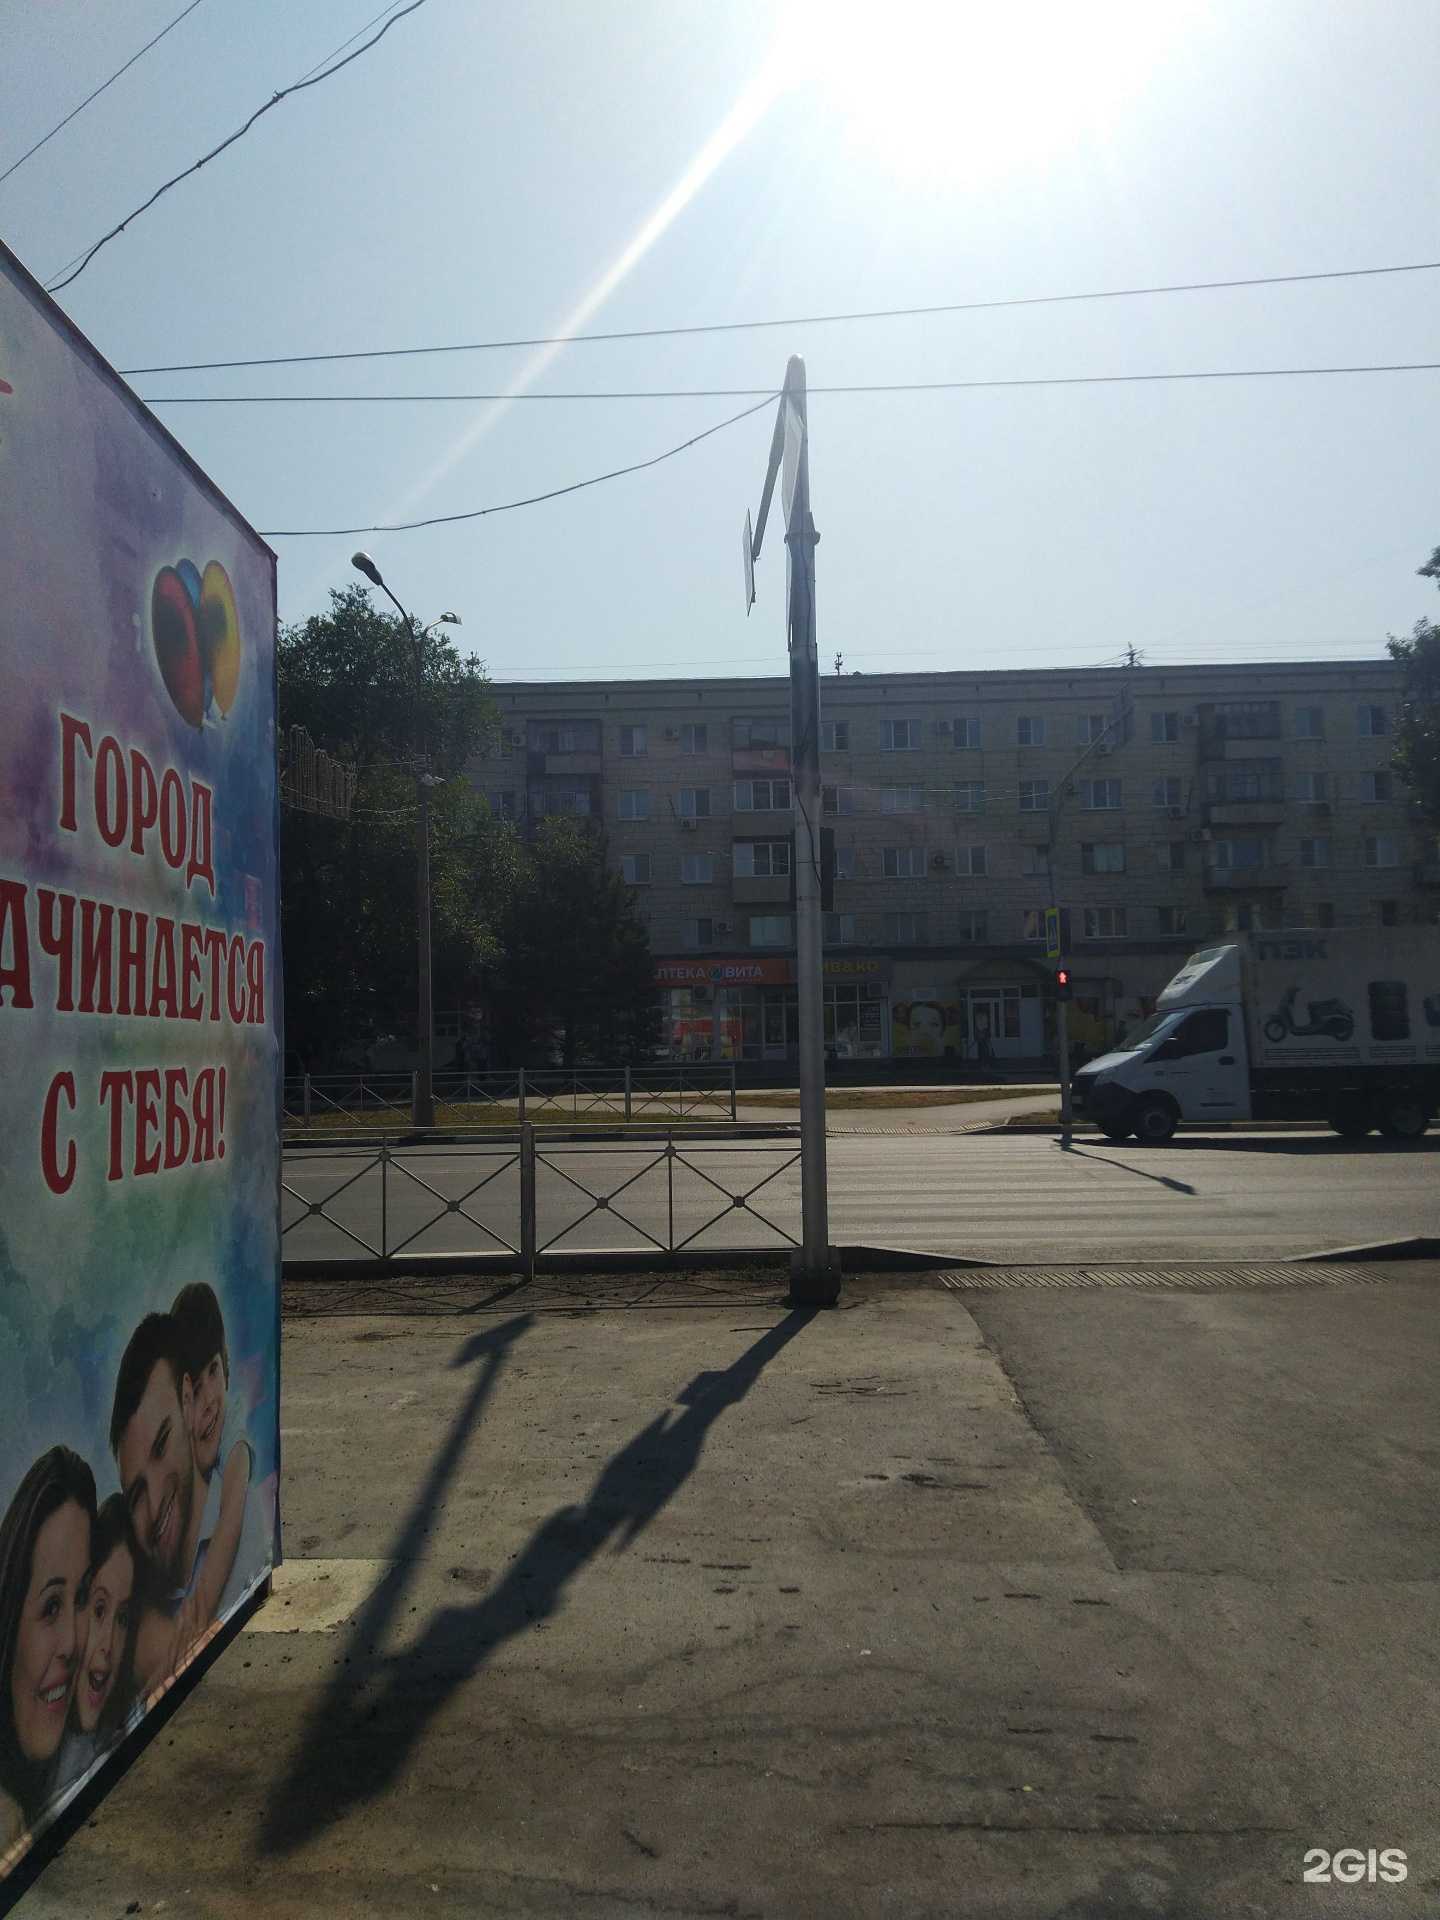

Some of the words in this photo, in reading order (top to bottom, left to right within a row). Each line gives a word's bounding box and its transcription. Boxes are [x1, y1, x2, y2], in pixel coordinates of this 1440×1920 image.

[60, 713, 214, 896] ГОРОД
[725, 966, 763, 978] ВИТА
[41, 1071, 77, 1194] С
[99, 1066, 227, 1181] ТЕБЯ!
